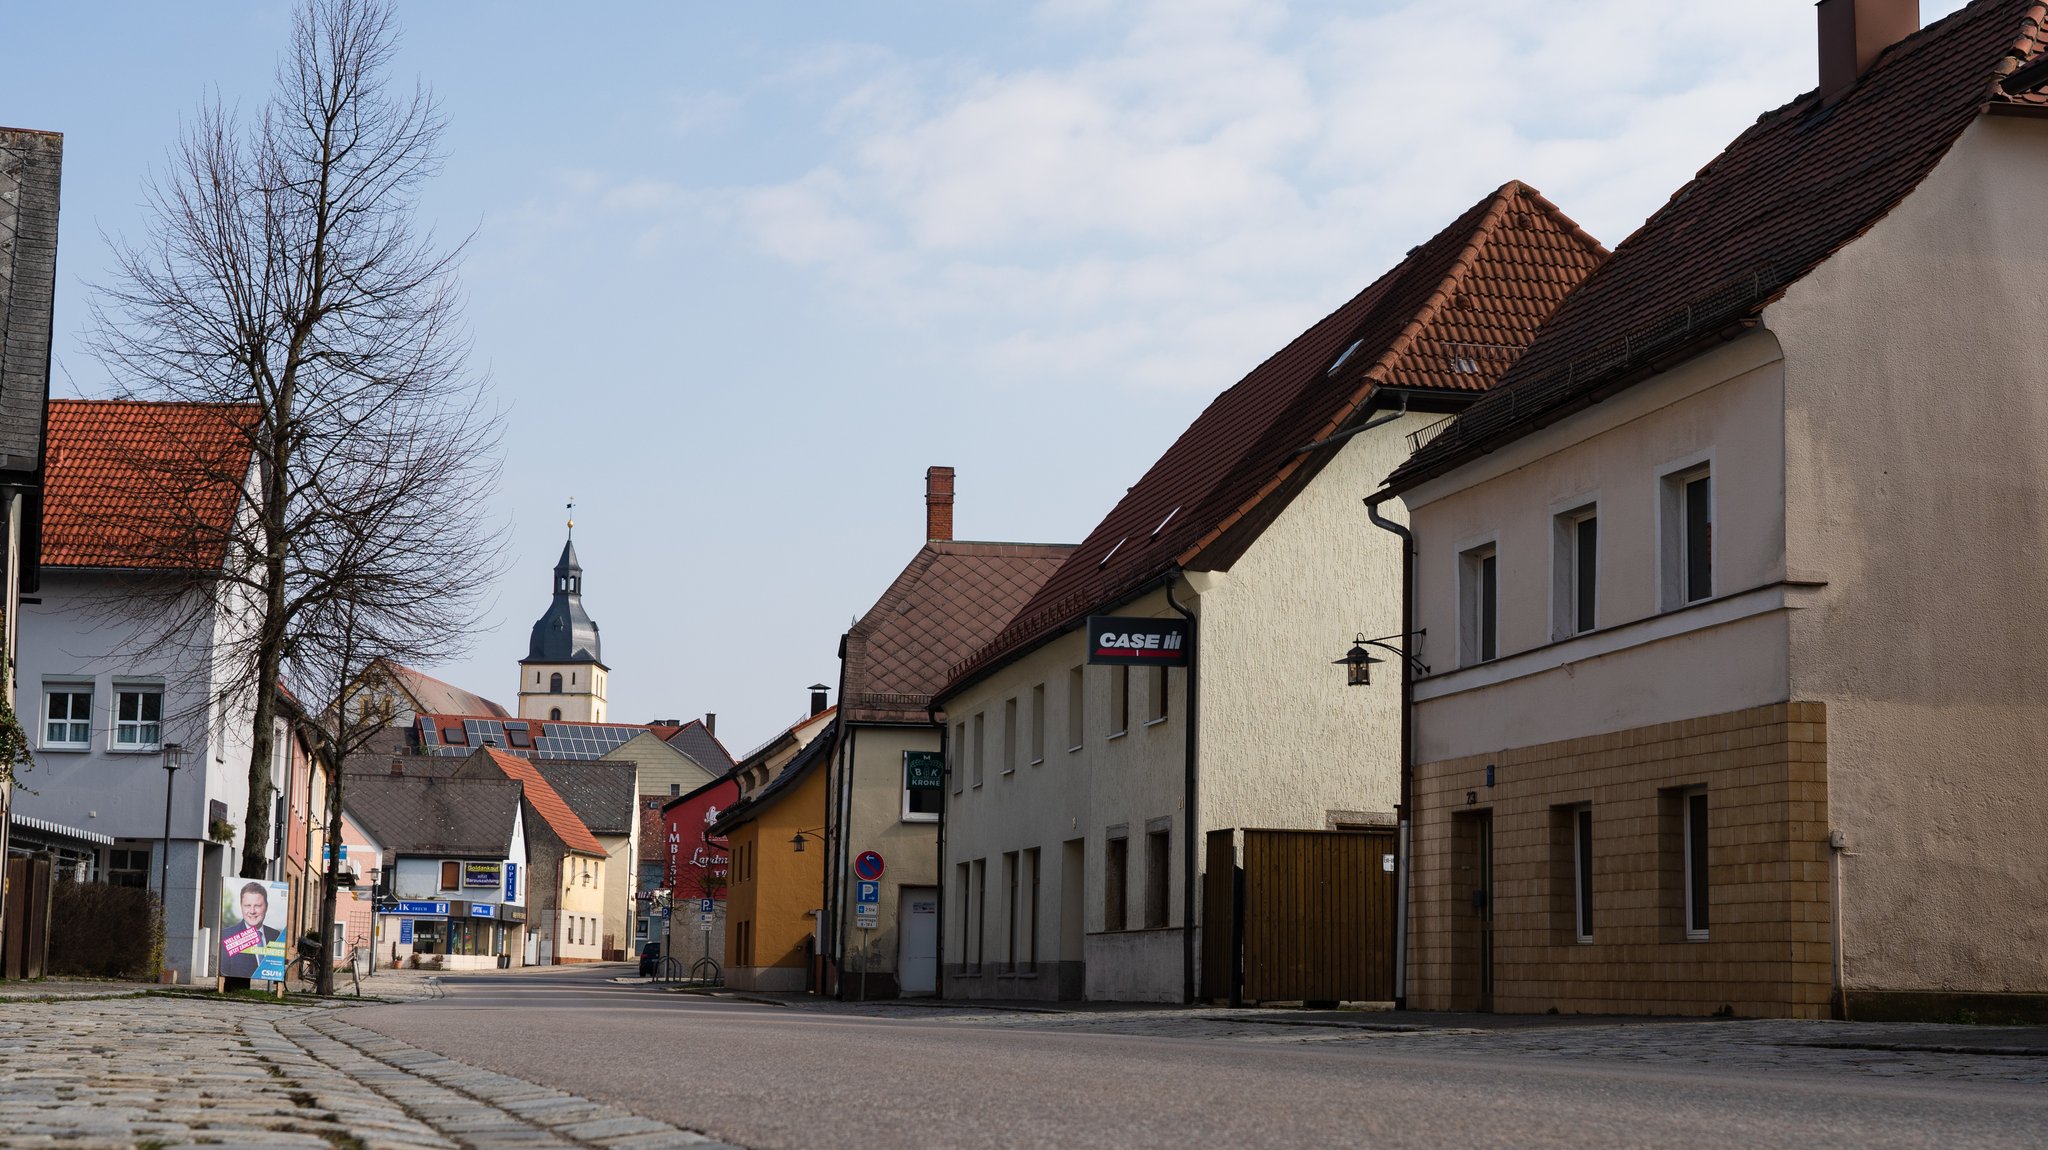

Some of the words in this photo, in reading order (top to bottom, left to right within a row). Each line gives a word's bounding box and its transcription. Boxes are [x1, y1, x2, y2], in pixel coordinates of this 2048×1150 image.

[1099, 632, 1161, 649] CASE
[914, 768, 922, 776] B
[930, 768, 938, 777] K
[912, 779, 941, 787] KRONE
[1466, 791, 1478, 805] 23
[862, 884, 874, 900] P
[703, 900, 710, 911] P
